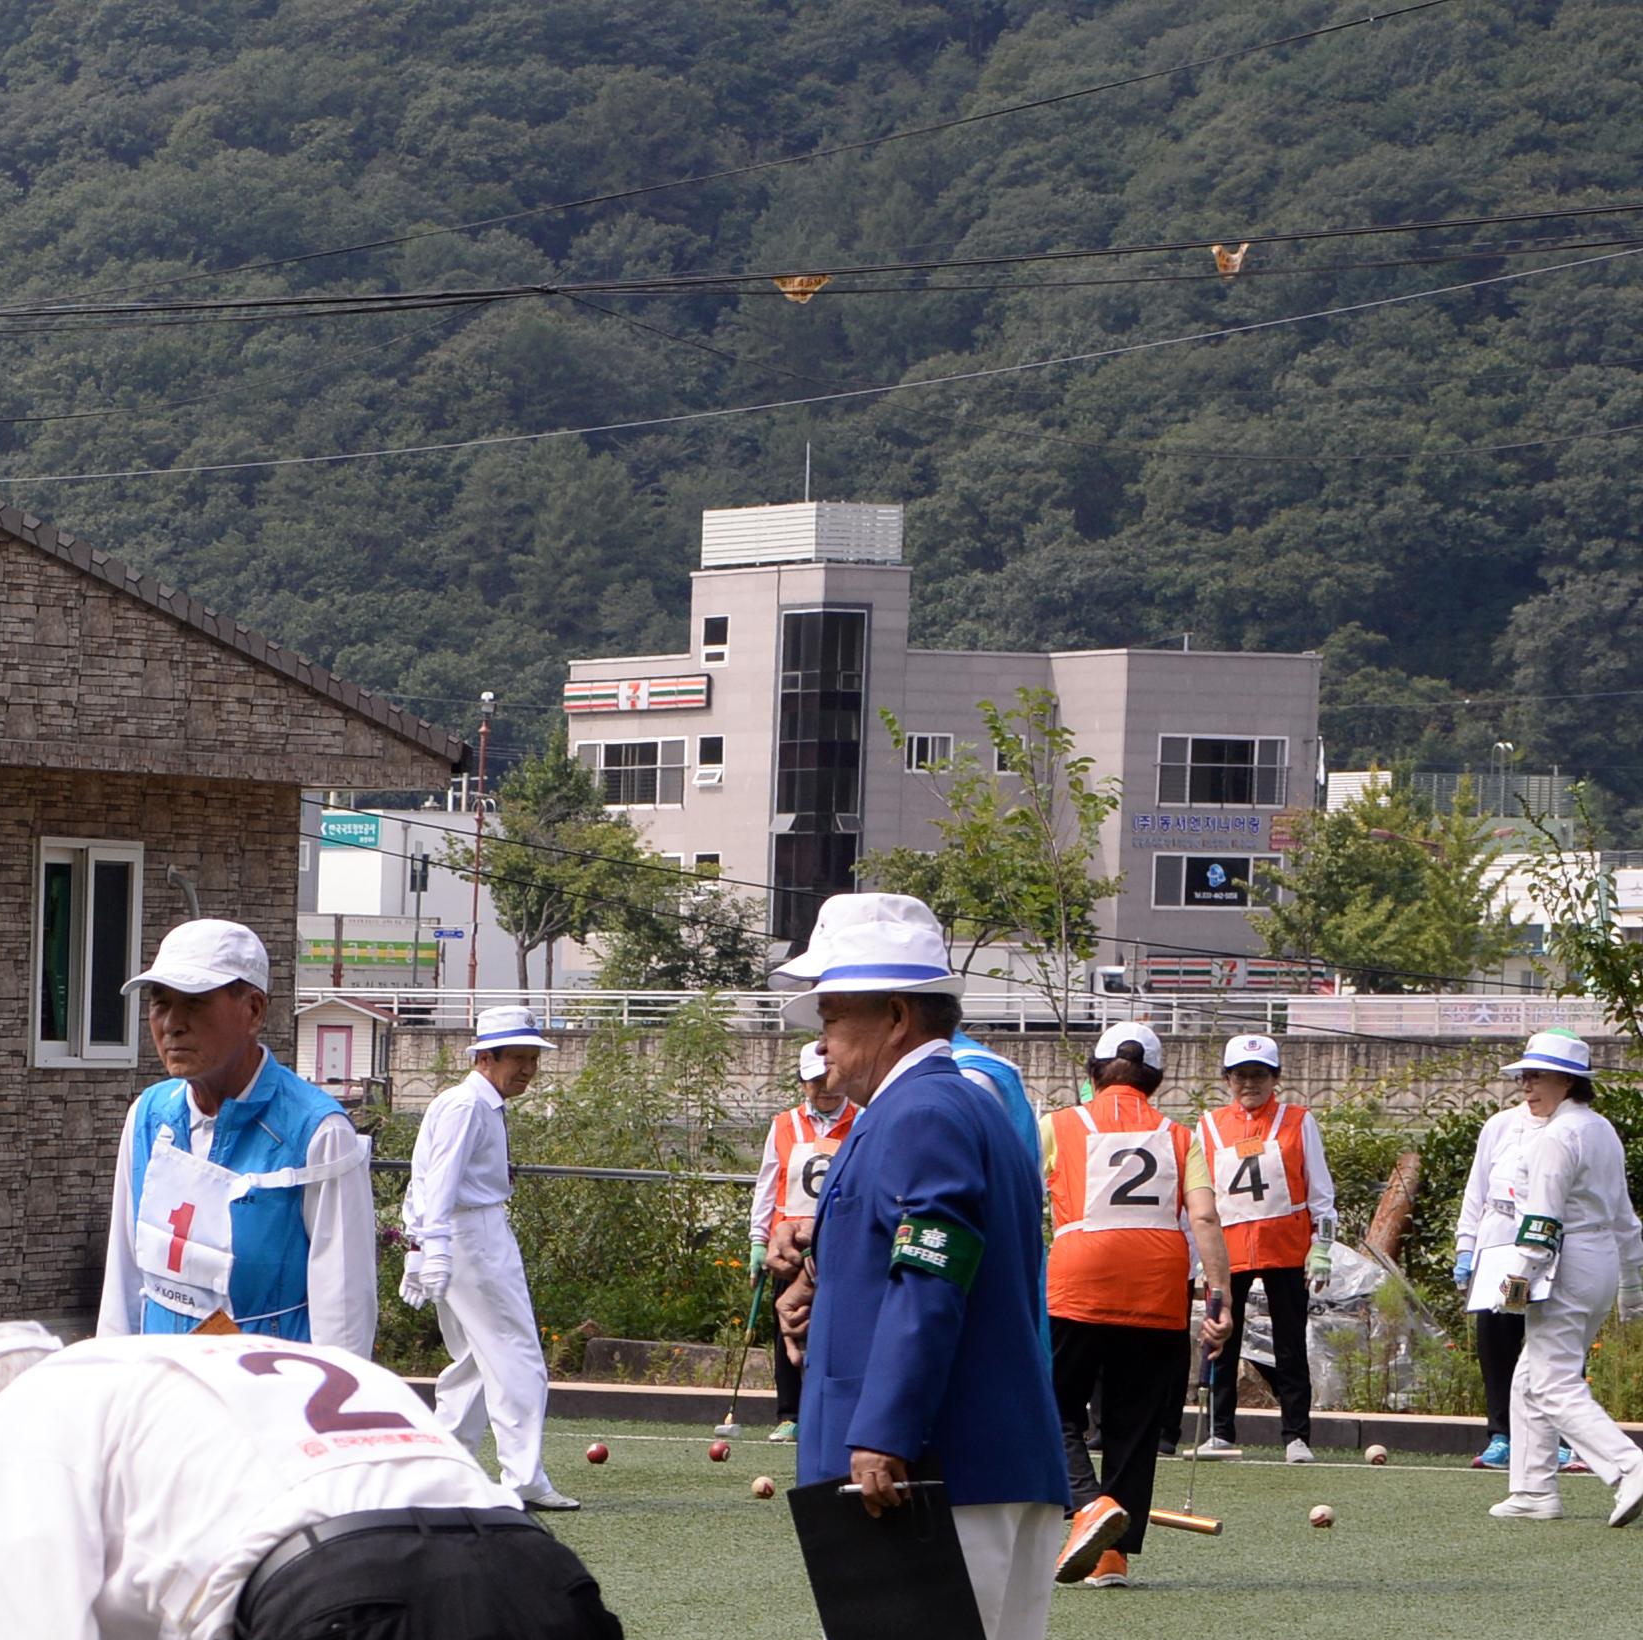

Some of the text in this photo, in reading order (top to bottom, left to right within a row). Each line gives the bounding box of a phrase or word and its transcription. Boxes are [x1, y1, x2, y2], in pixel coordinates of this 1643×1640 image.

[802, 1153, 834, 1199] 6
[1108, 1147, 1160, 1206] 2
[1228, 1157, 1270, 1202] 4
[167, 1201, 196, 1274] 1
[901, 1245, 949, 1268] REFEREE
[161, 1286, 196, 1308] KOREA
[237, 1352, 417, 1434] 2
